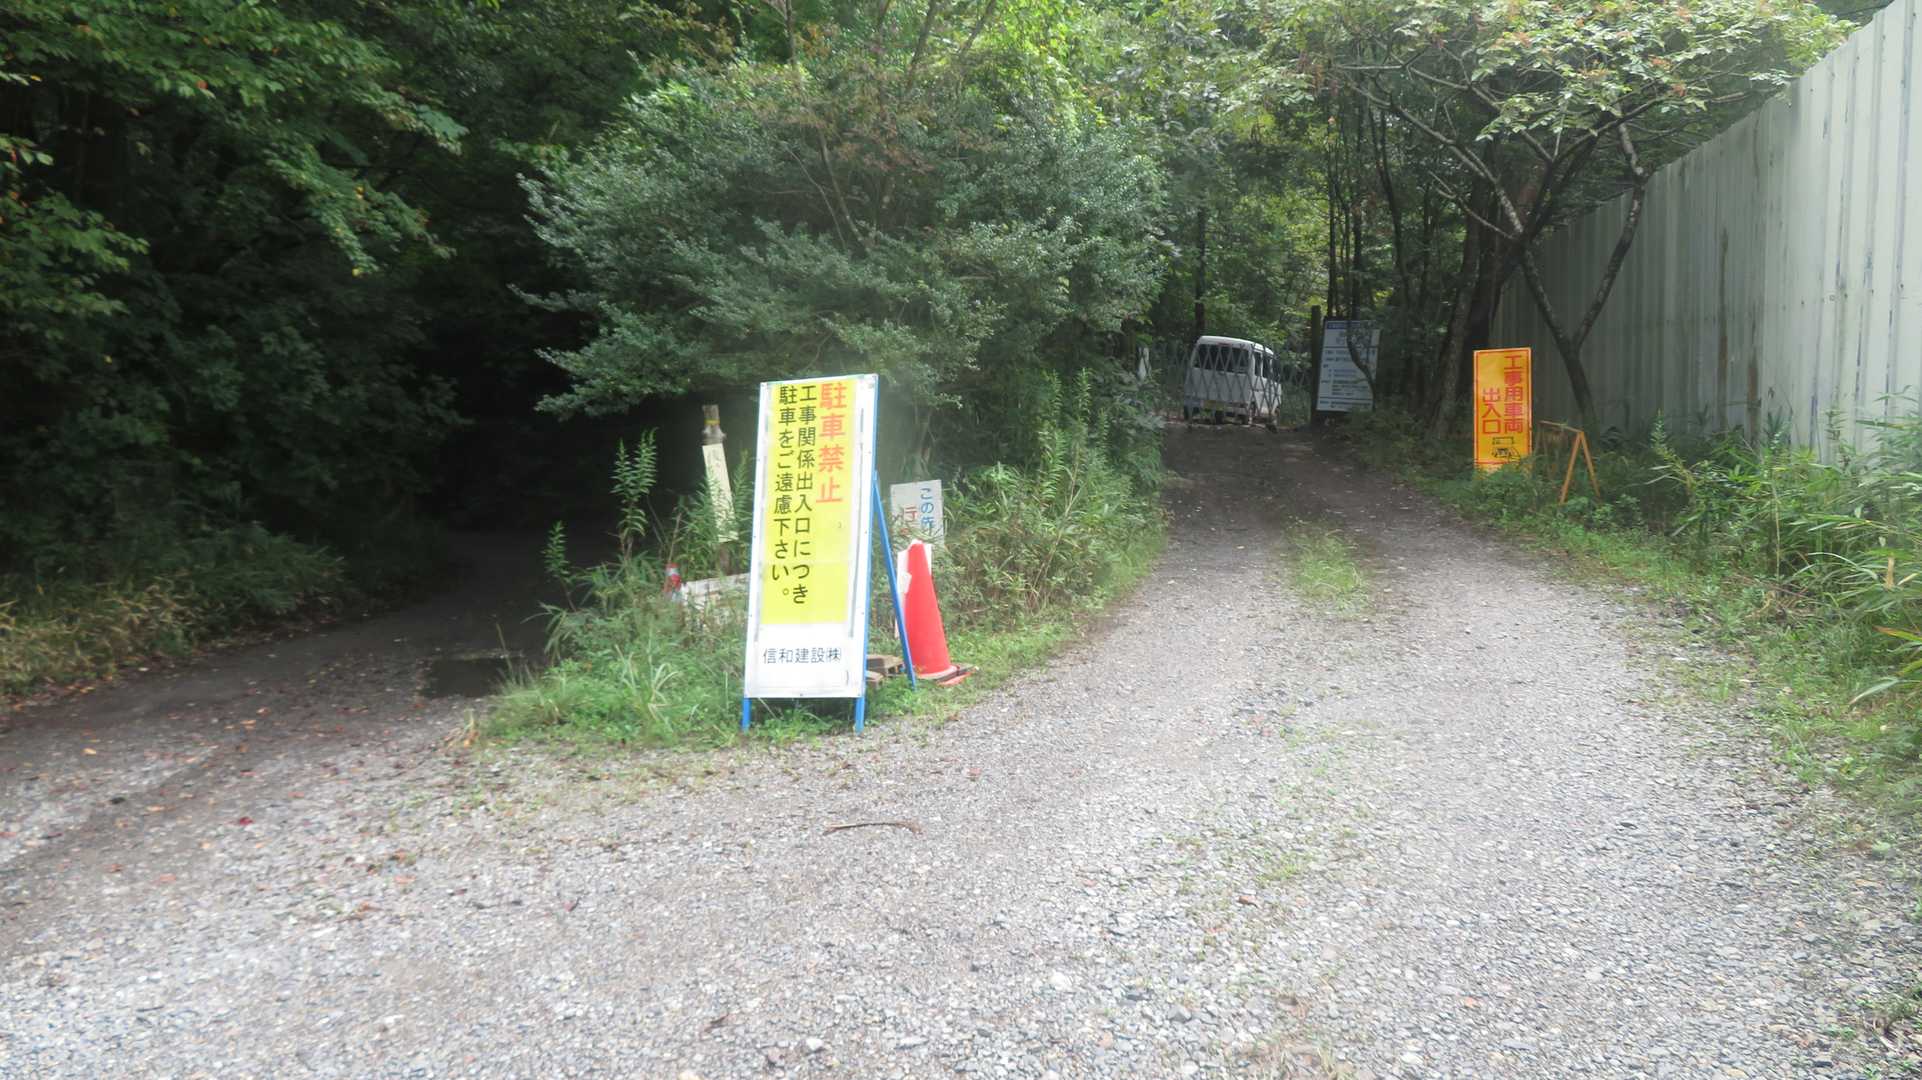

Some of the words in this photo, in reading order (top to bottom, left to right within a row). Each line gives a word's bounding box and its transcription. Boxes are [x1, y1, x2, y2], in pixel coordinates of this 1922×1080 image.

[816, 383, 847, 503] 駐車禁止
[1483, 387, 1502, 434] 出入口
[1504, 354, 1523, 433] 工事用車両
[772, 386, 798, 596] 駐車をご遠慮下さい。
[792, 385, 817, 604] 工事関係出入口につき
